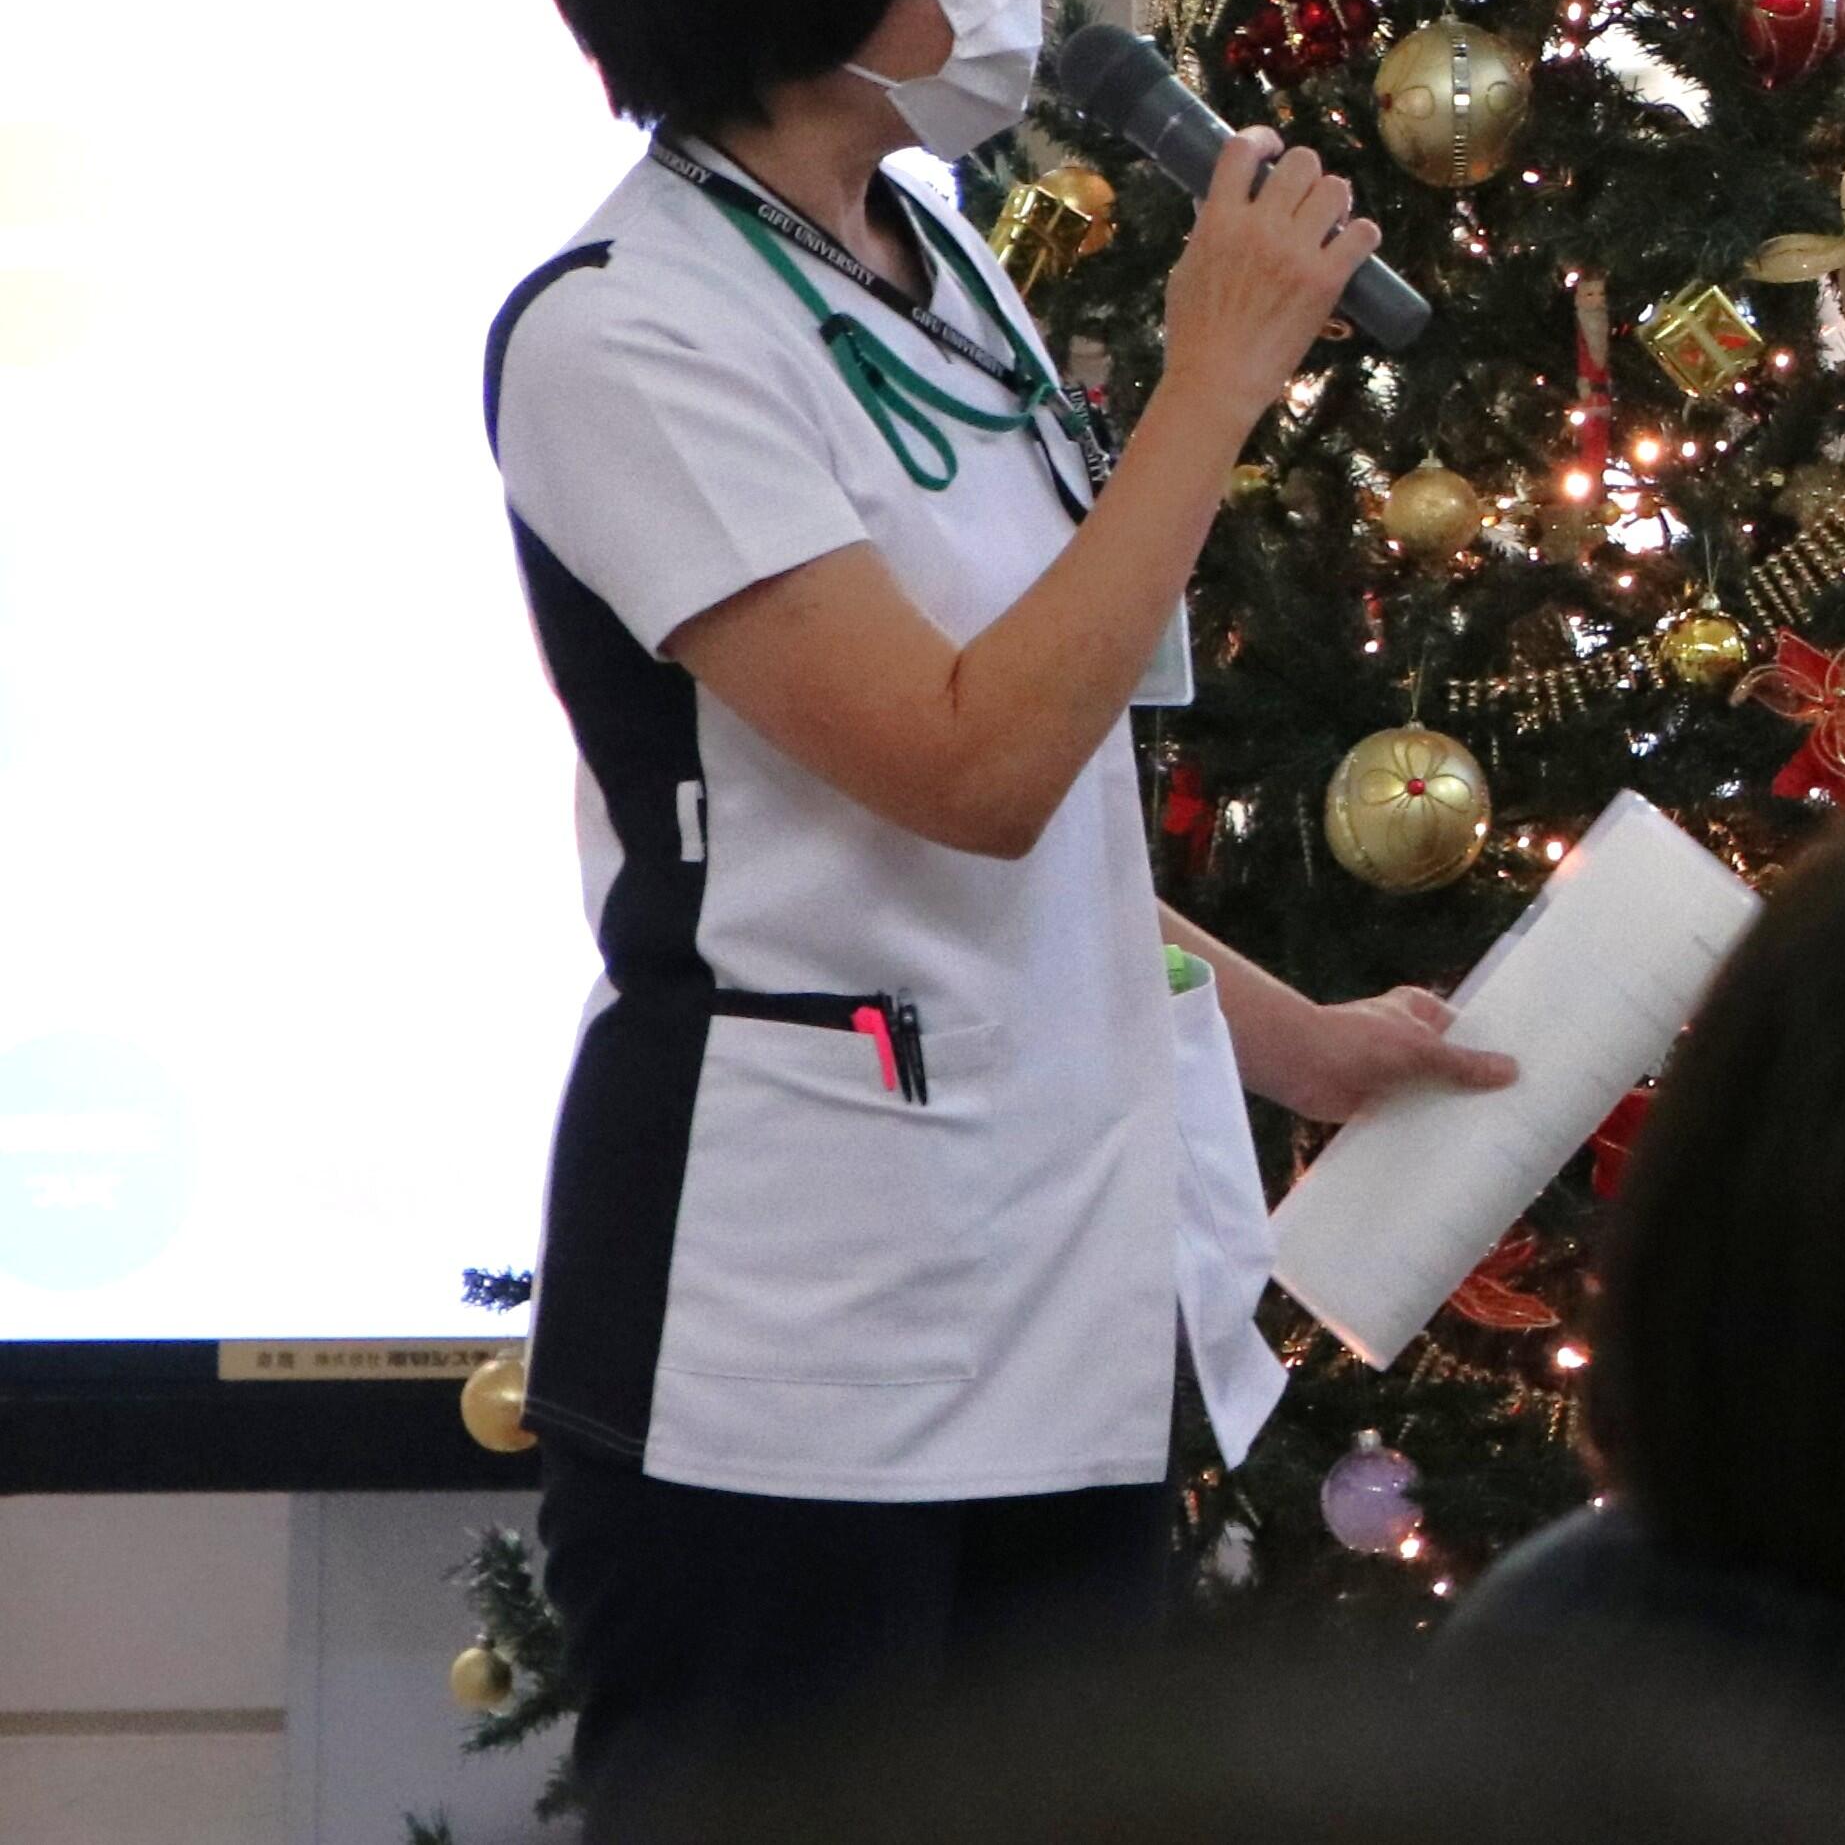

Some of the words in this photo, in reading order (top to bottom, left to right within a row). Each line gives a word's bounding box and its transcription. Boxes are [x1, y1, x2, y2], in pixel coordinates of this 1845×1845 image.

[757, 203, 796, 234] GIFU
[794, 225, 876, 287] UNIVERSITY
[911, 306, 943, 333] GIFU
[942, 323, 1005, 379] UNIVERSITY
